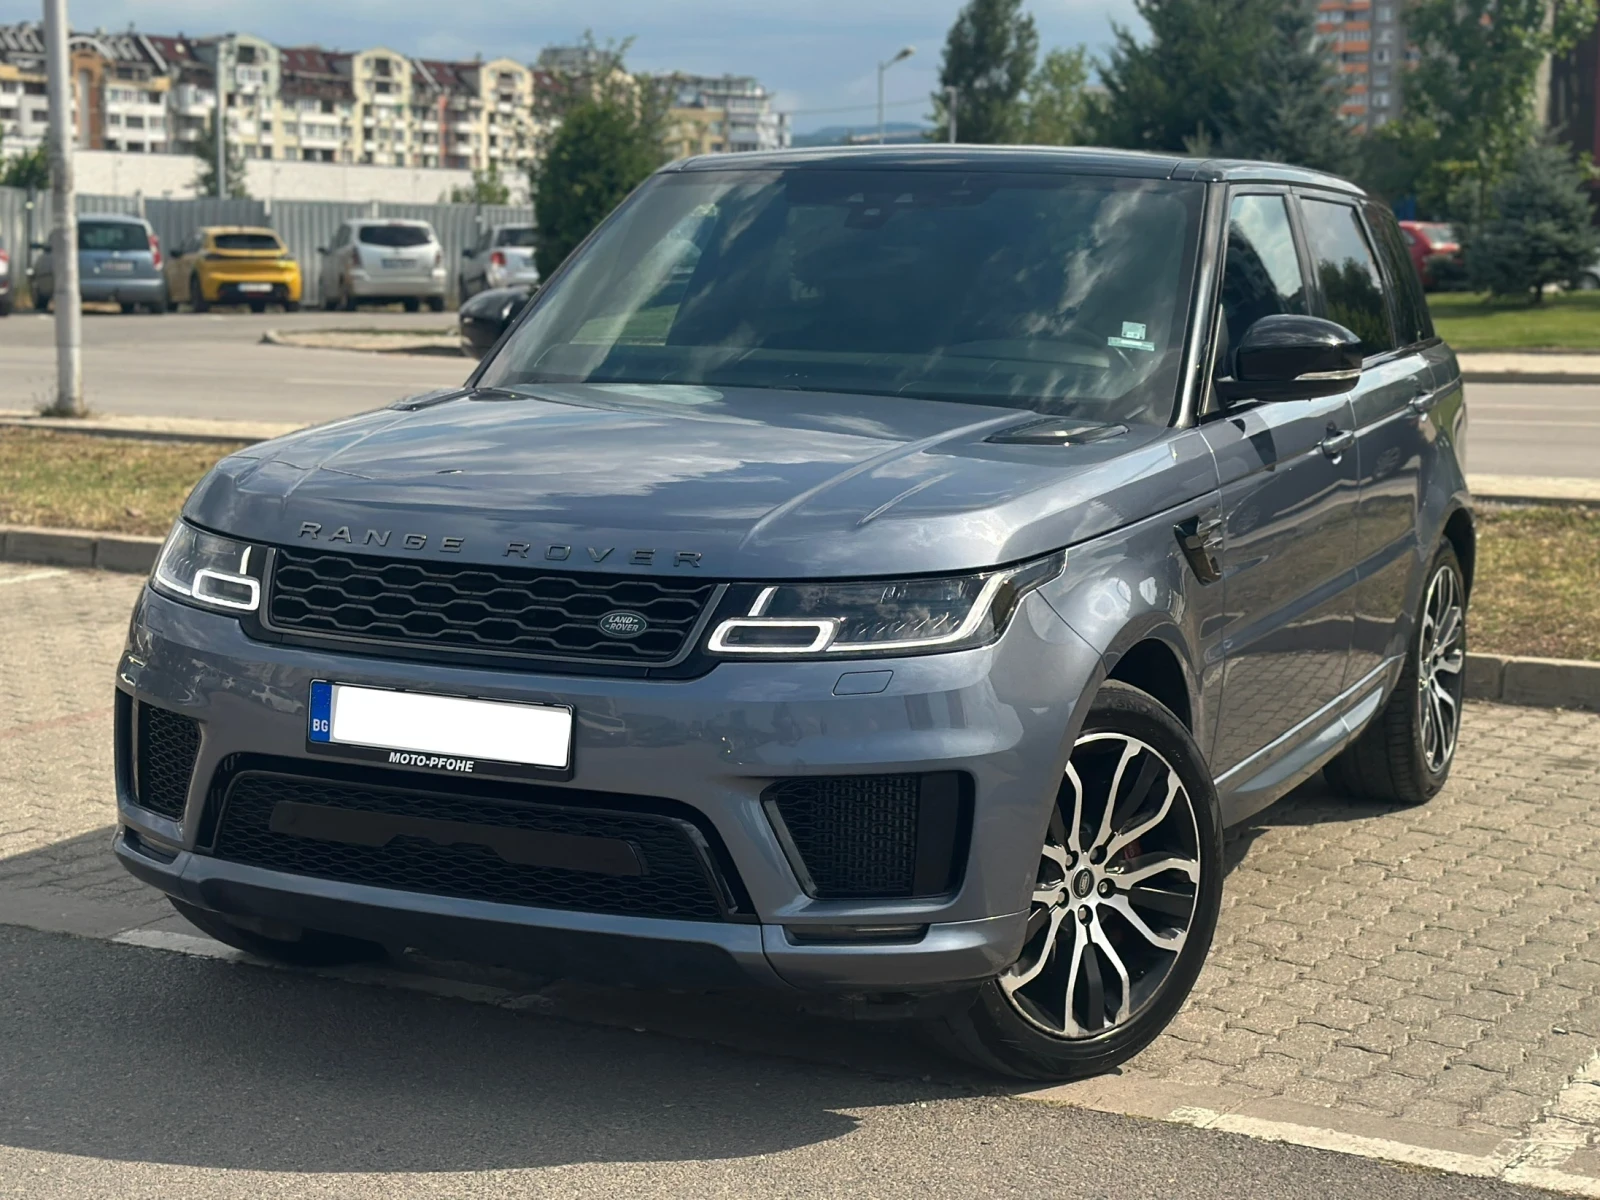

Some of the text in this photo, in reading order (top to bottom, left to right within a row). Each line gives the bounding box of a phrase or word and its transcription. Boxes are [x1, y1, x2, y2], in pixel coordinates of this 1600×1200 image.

[298, 520, 702, 568] RANGE ROVER
[312, 718, 329, 732] BG
[388, 751, 474, 773] MOTO-PFOHE
